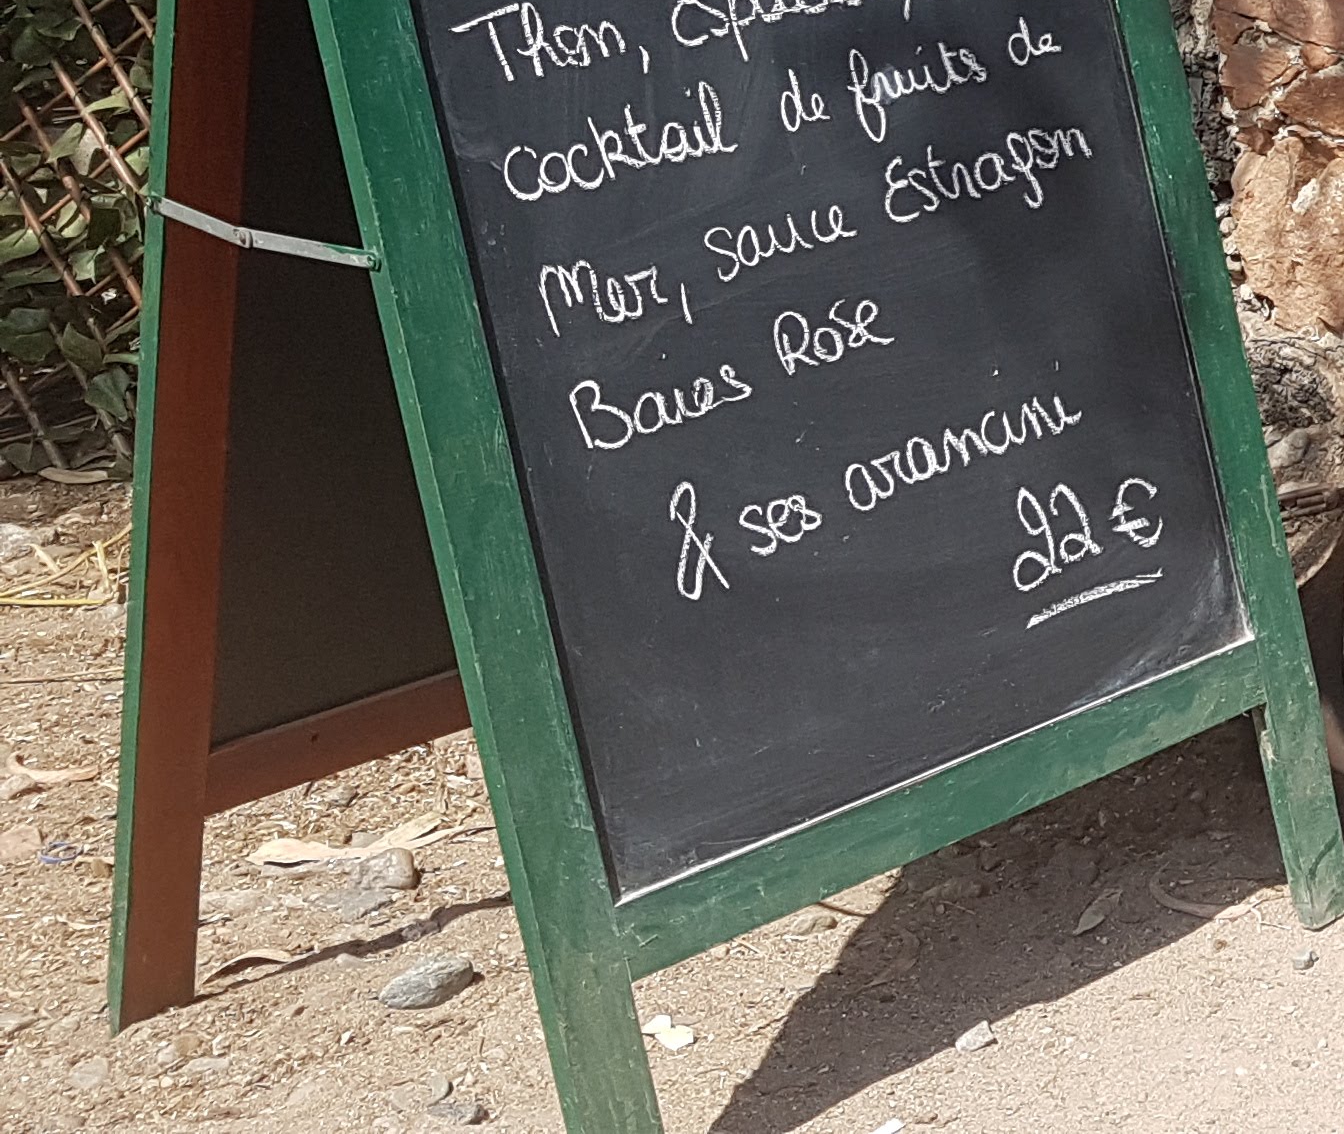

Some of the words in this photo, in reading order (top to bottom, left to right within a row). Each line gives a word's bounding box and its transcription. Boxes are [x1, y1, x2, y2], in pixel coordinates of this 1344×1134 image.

[780, 69, 830, 133] de
[847, 44, 987, 142] fruits
[1008, 16, 1062, 66] de
[568, 357, 753, 450] Baies
[669, 481, 730, 601] &
[739, 494, 823, 556] ses
[845, 361, 1083, 511] arancini
